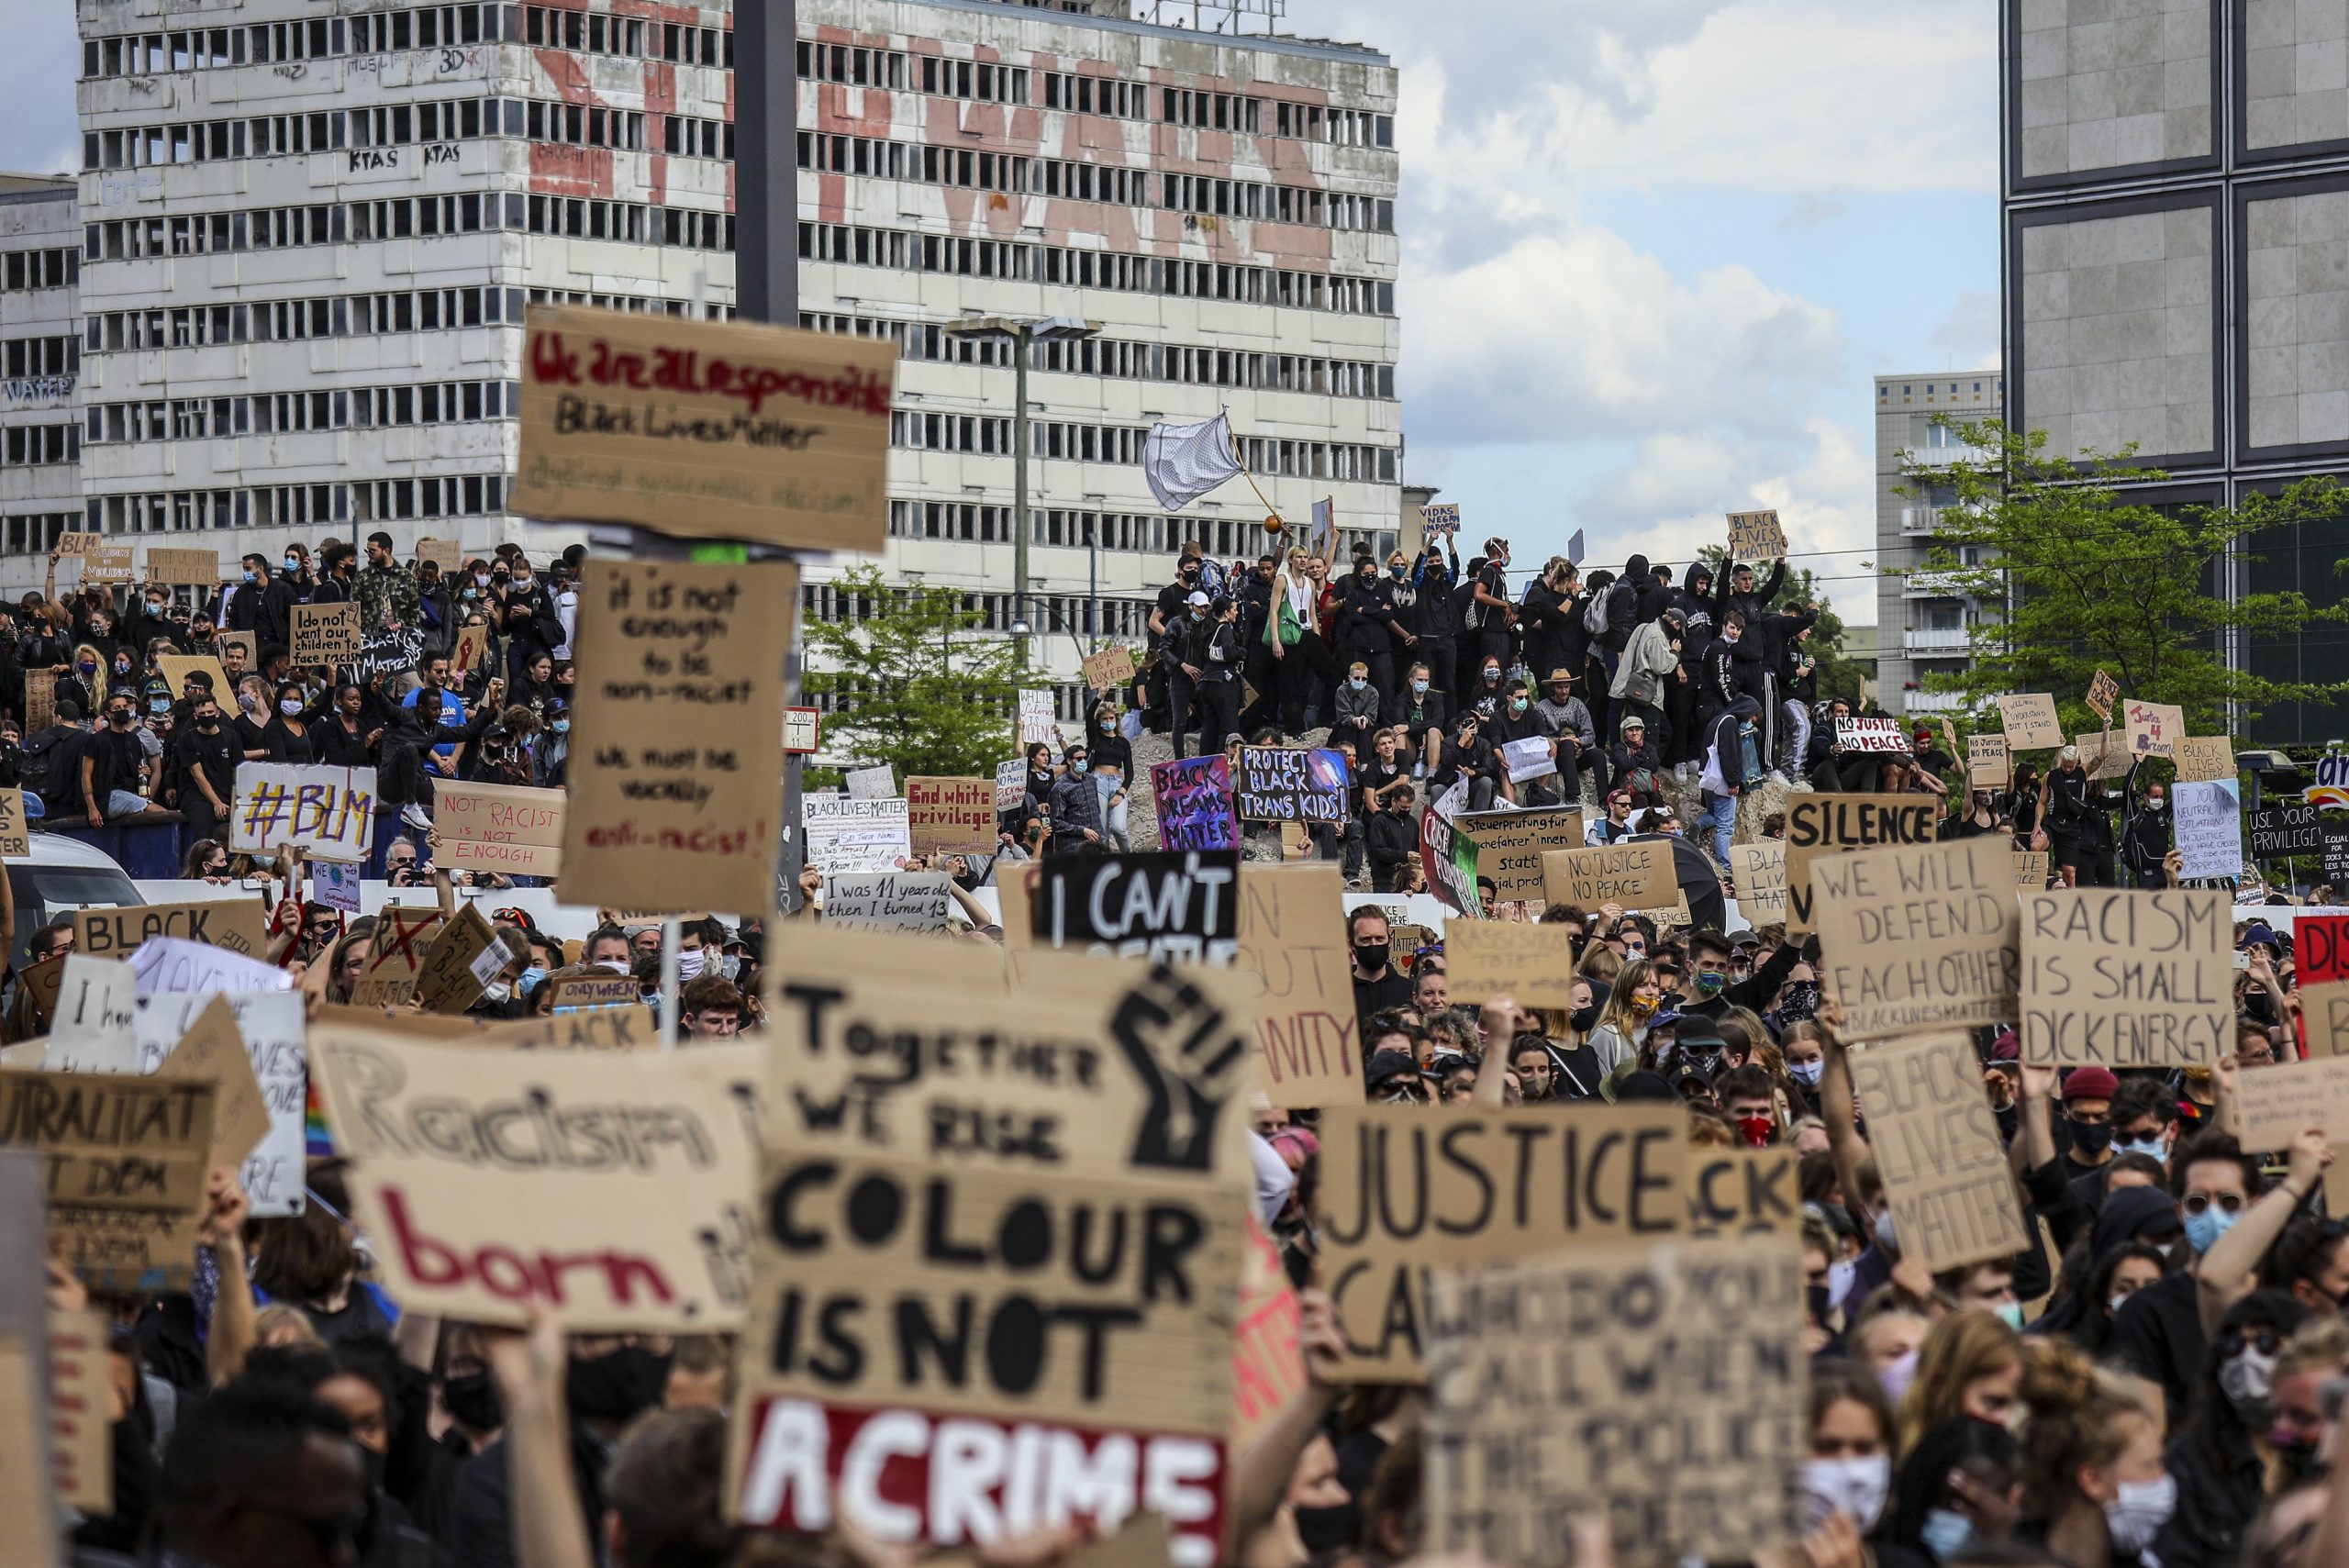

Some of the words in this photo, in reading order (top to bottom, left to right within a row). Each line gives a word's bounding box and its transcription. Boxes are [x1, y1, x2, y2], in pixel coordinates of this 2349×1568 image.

[1419, 507, 1453, 517] VIDAS
[1732, 514, 1778, 530] BLACK
[1735, 528, 1777, 543] LIVES
[1739, 542, 1783, 560] MATTER
[682, 581, 741, 612] not
[304, 610, 318, 628] do
[323, 609, 346, 627] not
[295, 628, 322, 640] want
[326, 628, 351, 639] our
[361, 629, 401, 650] BLACK
[621, 614, 729, 651] enough
[295, 640, 341, 651] children
[346, 639, 360, 651] to
[1099, 646, 1126, 661] SILENCE
[294, 651, 319, 663] face
[642, 652, 671, 676] to
[1095, 661, 1104, 670] IS
[1088, 664, 1131, 685] LUXERY
[2096, 671, 2117, 698] SILENCE
[1020, 691, 1052, 704] WHITE
[1029, 717, 1039, 726] IS
[1838, 717, 1854, 730] NO
[1856, 717, 1901, 732] JUSTICE
[2030, 720, 2052, 729] STAND
[2150, 725, 2162, 740] 4
[1842, 737, 1861, 751] NO
[1860, 735, 1906, 751] PEACE
[1982, 749, 2004, 758] PEACE
[2183, 745, 2222, 758] BLACK
[1244, 750, 1308, 773] PROTECT
[2187, 758, 2224, 771] LIVES
[1154, 761, 1221, 794] BLACK
[1249, 770, 1309, 793] BLACK
[2185, 770, 2223, 783] MATTER
[908, 784, 941, 805] End
[945, 784, 990, 806] white
[2176, 788, 2188, 803] IF
[2196, 788, 2218, 803] YOU
[243, 781, 373, 849] #BLM
[444, 795, 483, 814] NOT
[489, 802, 561, 828] RACIST
[1159, 791, 1232, 822] DREAMS
[1241, 793, 1293, 819] TRANS
[1299, 792, 1347, 823] KIDS!
[2176, 805, 2214, 819] NEUTRAL
[908, 806, 991, 832] privilege
[1465, 816, 1547, 833] Steuerprüfung
[1547, 814, 1568, 828] für
[1790, 801, 1935, 847] SILENCE
[2178, 817, 2224, 831] SITUATIONS
[2227, 816, 2238, 824] OF
[2249, 811, 2273, 830] USE
[2281, 806, 2316, 826] YOUR
[460, 828, 472, 836] IS
[483, 830, 518, 843] NOT
[1165, 821, 1233, 851] MATTER
[456, 841, 535, 864] ENOUGH
[1498, 854, 1540, 871] statt
[2201, 849, 2218, 857] SIDE
[314, 862, 328, 877] WE
[1568, 853, 1591, 879] NO
[1594, 850, 1652, 879] JUSTICE
[1819, 860, 1876, 899] WE
[1895, 846, 1988, 894] WILL
[345, 879, 356, 889] you
[828, 876, 837, 899] I
[841, 885, 871, 897] was
[875, 876, 895, 899] 11
[899, 885, 930, 902] years
[1572, 880, 1591, 901] NO
[828, 902, 863, 917] then
[871, 900, 878, 917] I
[884, 900, 925, 916] turned
[1052, 874, 1064, 950] I
[1088, 852, 1233, 938] CAN'T
[1854, 894, 2006, 945] DEFEND
[2032, 894, 2219, 954] RACISM
[1390, 929, 1419, 952] MATTER
[1835, 958, 1927, 1007] EACH
[1937, 946, 2022, 1000] OTHER
[2031, 955, 2071, 996] IS
[2092, 956, 2217, 1006] SMALL
[565, 981, 595, 998] ONLY
[596, 980, 636, 997] WHEN
[73, 980, 90, 1026] I
[2026, 1009, 2108, 1062] DICK
[2113, 1012, 2229, 1064] ENERGY
[1857, 1040, 1986, 1119] BLACK
[932, 1102, 1063, 1162] RISE
[1873, 1103, 2003, 1185] LIVES
[1322, 1119, 1681, 1246] JUSTICE
[1894, 1173, 2024, 1265] MATTER
[768, 1160, 1204, 1307] COLOUR
[774, 1290, 865, 1385] IS
[896, 1295, 1145, 1403] NOT
[737, 1393, 831, 1528] A
[838, 1407, 1219, 1568] CRIME
